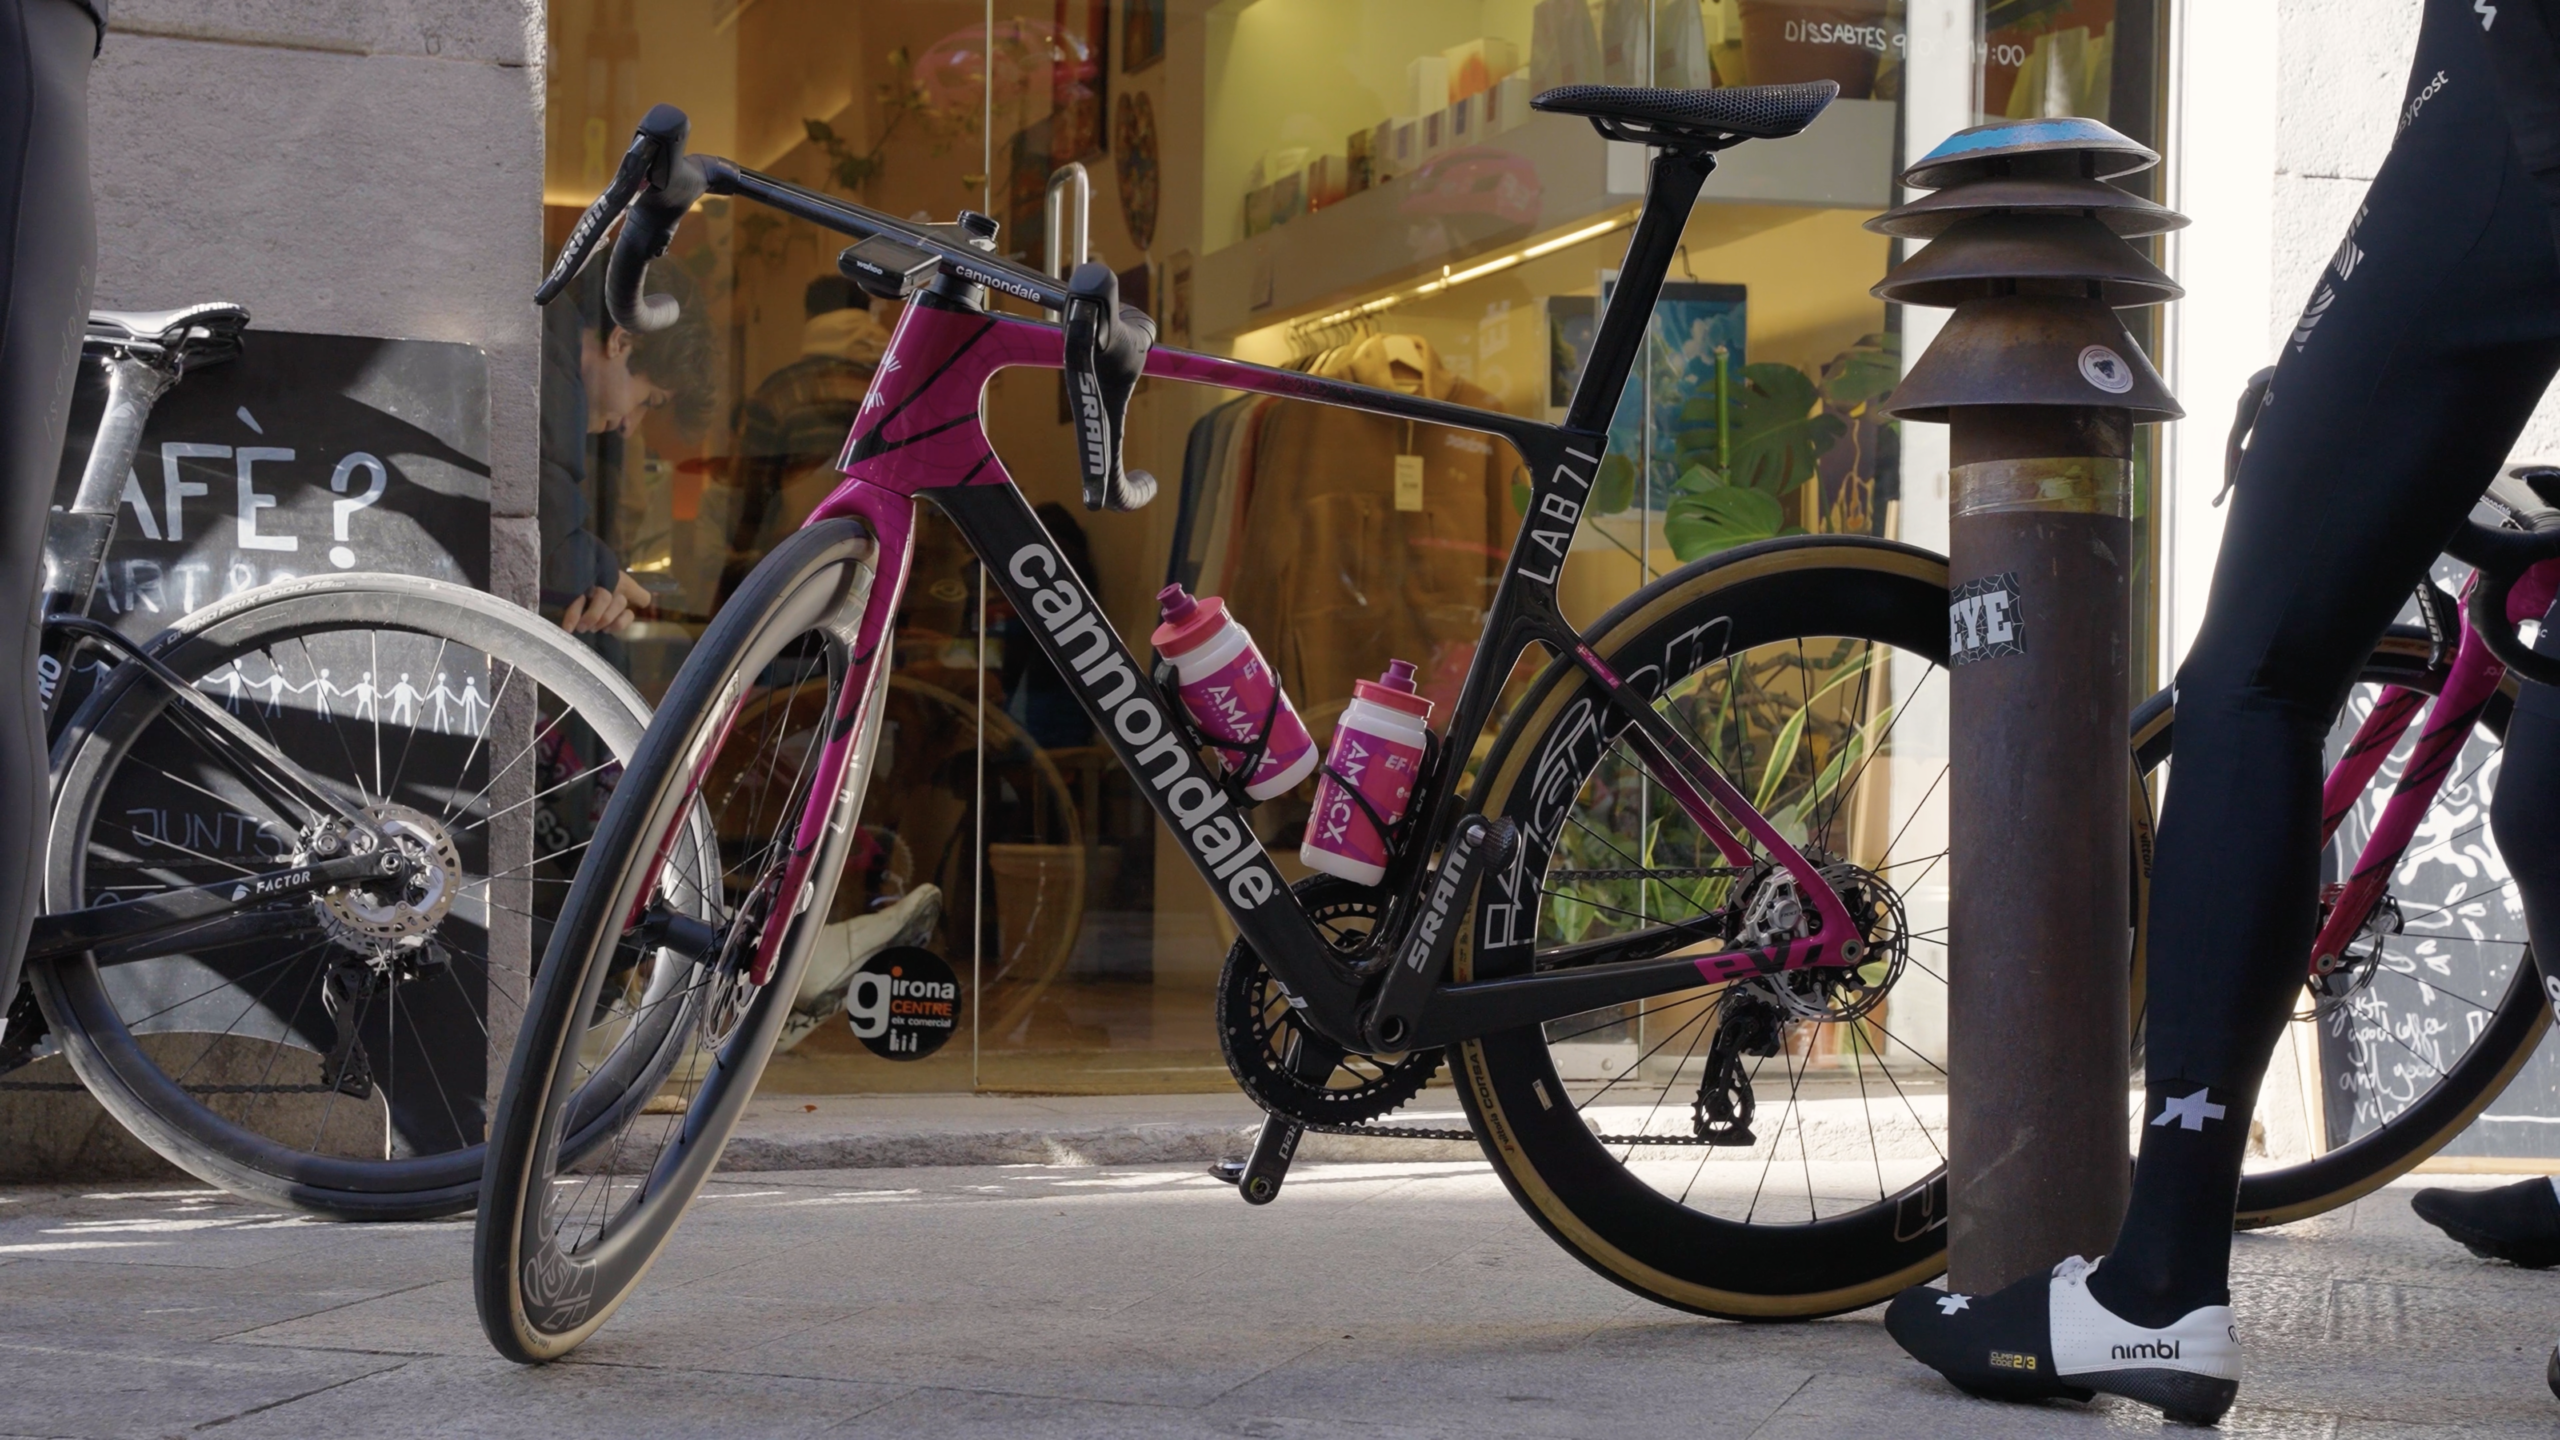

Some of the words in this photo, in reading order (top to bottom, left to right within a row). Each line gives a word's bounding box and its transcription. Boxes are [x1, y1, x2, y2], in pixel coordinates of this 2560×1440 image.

[553, 194, 610, 282] SRAM
[856, 259, 883, 276] wahoo
[955, 264, 1042, 303] cannondale
[1078, 371, 1105, 475] SRAM
[1517, 446, 1599, 585] LAB71
[1243, 657, 1260, 681] EF
[1008, 542, 1274, 910] cannondale
[1384, 754, 1408, 771] EF
[125, 807, 284, 864] JUNTS
[256, 870, 311, 894] FACTOR
[1406, 838, 1472, 974] SRAM
[891, 999, 953, 1017] CENTRE
[907, 1017, 952, 1029] comercial
[2347, 1010, 2395, 1067] good
[1469, 1053, 1494, 1109] CORSA
[2339, 1042, 2393, 1094] and
[2389, 1039, 2447, 1101] good
[2111, 1338, 2180, 1361] nimbl
